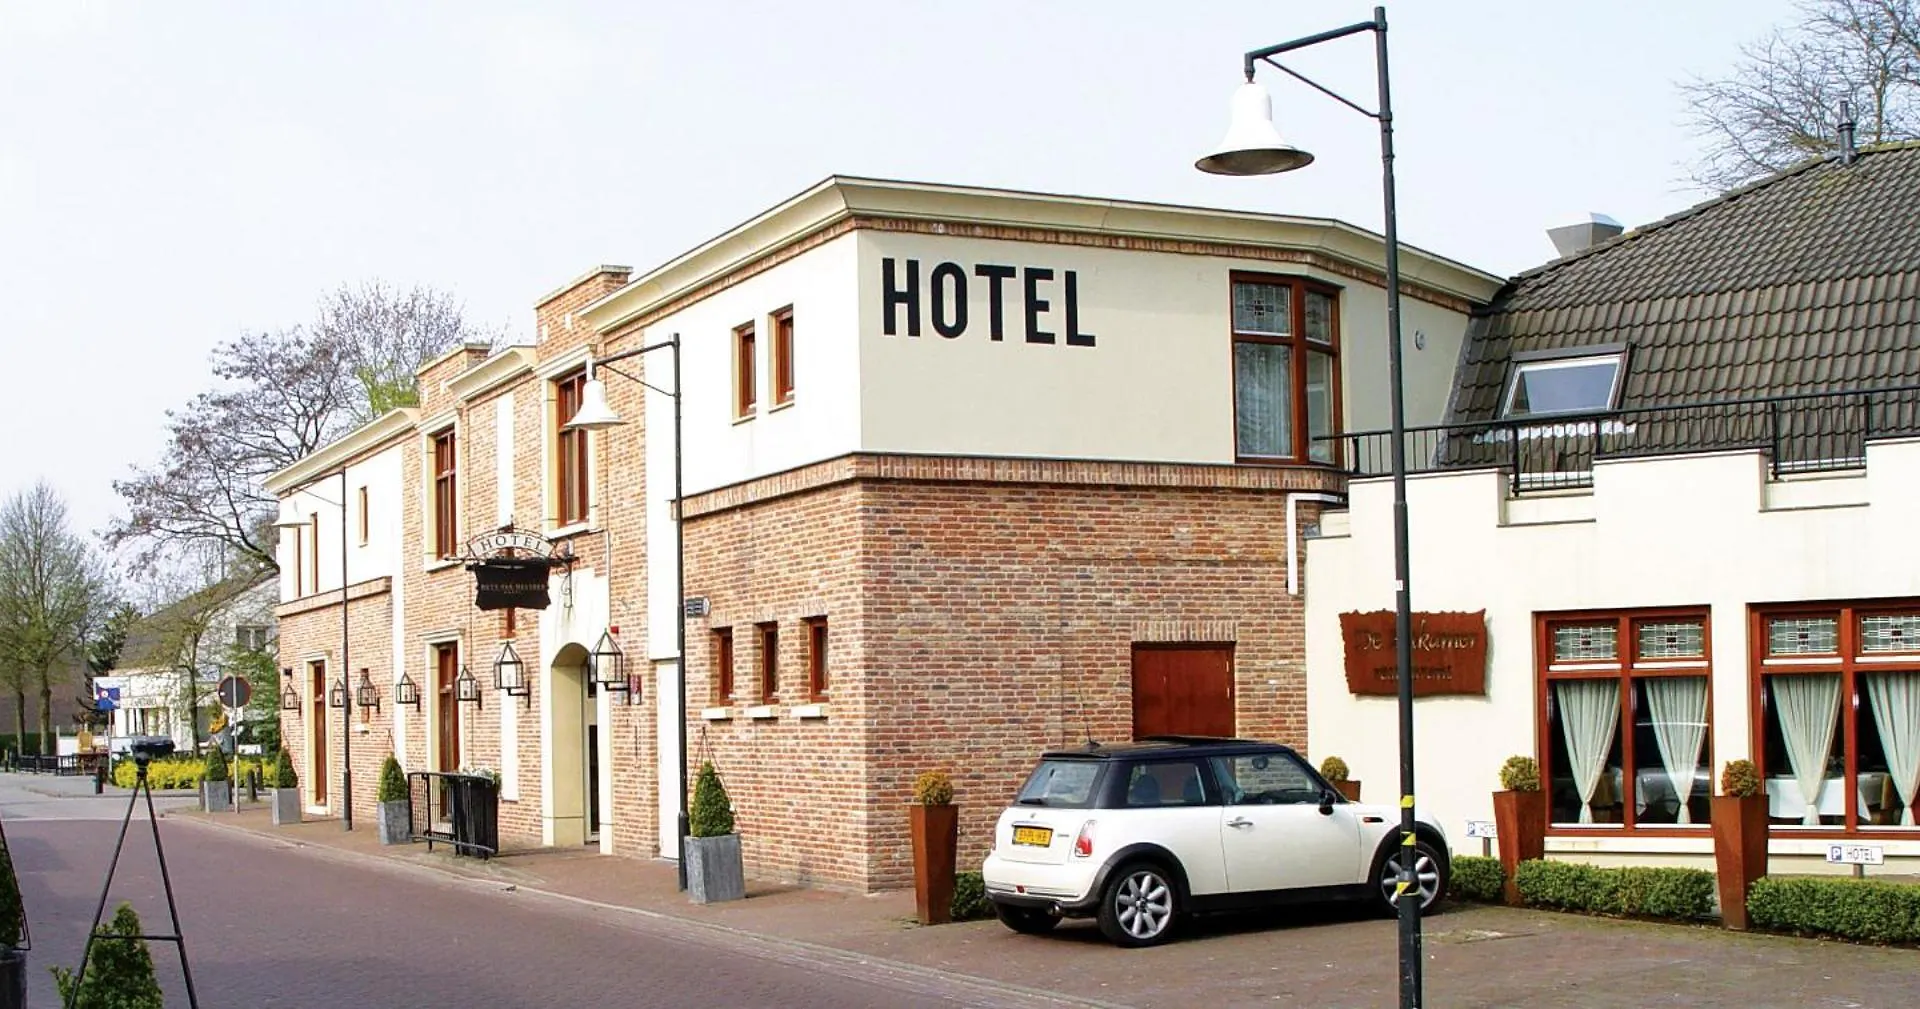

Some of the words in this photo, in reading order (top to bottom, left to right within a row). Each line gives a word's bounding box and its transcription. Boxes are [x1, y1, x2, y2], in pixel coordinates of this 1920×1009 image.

[882, 257, 1096, 347] HOTEL
[480, 534, 544, 552] HOTEL
[1479, 824, 1497, 835] HOTE
[1832, 847, 1842, 860] P
[1847, 847, 1876, 861] HOTEL
